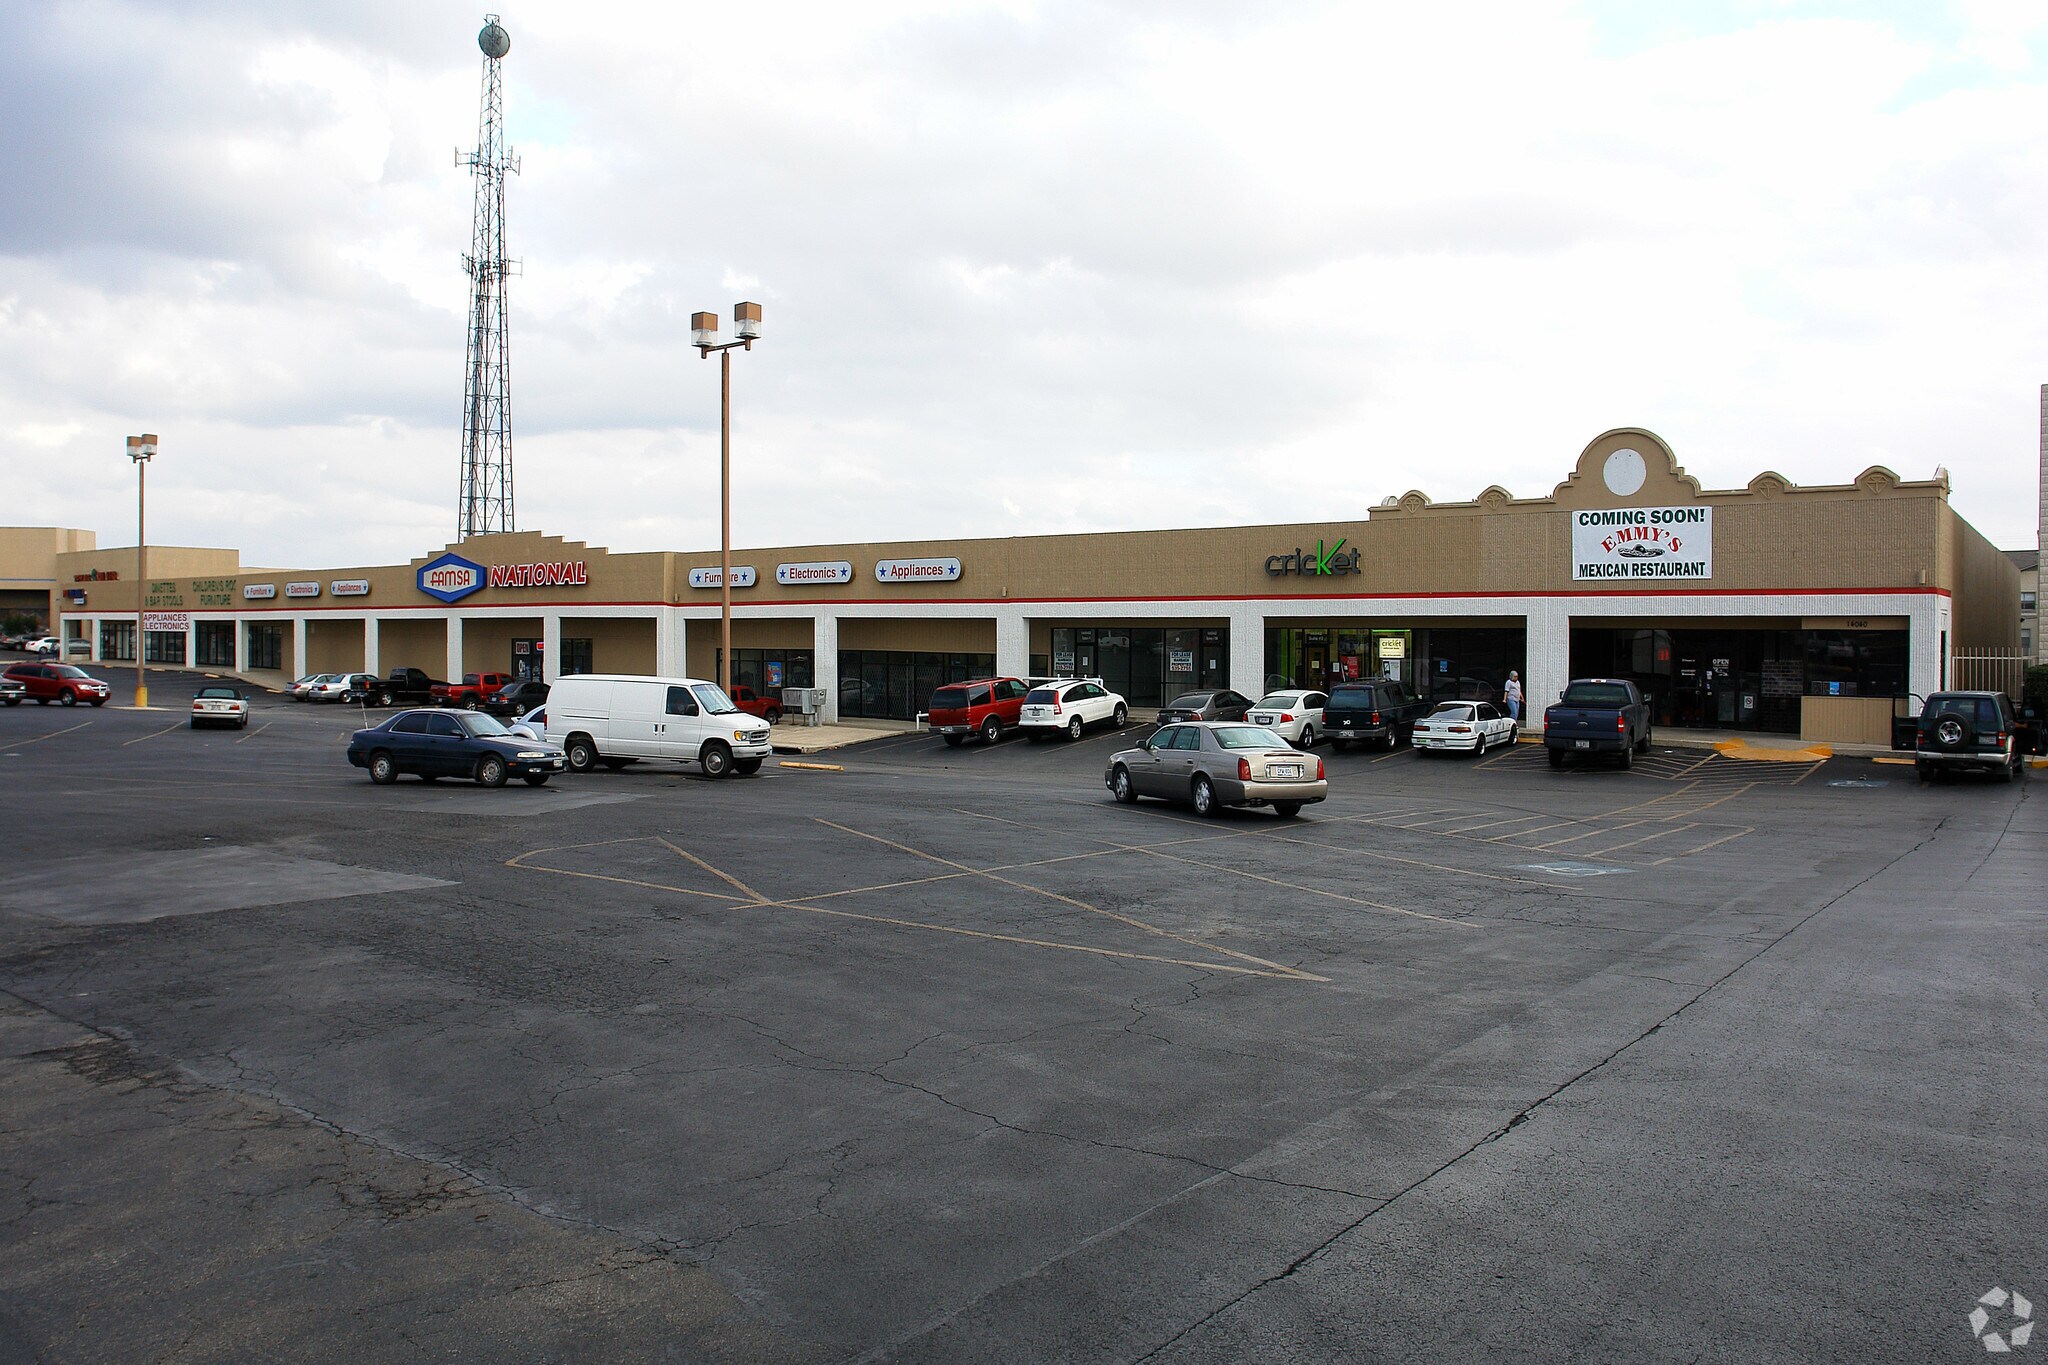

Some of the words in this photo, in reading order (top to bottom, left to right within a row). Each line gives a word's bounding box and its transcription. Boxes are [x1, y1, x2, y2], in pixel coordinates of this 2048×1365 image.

[1579, 510, 1646, 526] COMING
[1650, 508, 1705, 524] SOON!
[1600, 526, 1684, 553] EMMY'S
[1264, 538, 1361, 576] cricket
[489, 561, 588, 588] NATIONAL
[789, 566, 837, 579] Electronics
[890, 564, 944, 580] Appliances
[1578, 562, 1629, 578] MEXICAN
[1631, 562, 1706, 577] RESTAURANT
[704, 572, 739, 583] Furnre
[250, 587, 268, 596] Furniture
[290, 585, 313, 594] Electronics
[337, 583, 362, 593] Appliances
[144, 613, 188, 622] APPLIANCES
[143, 622, 190, 631] ELECTRONICS
